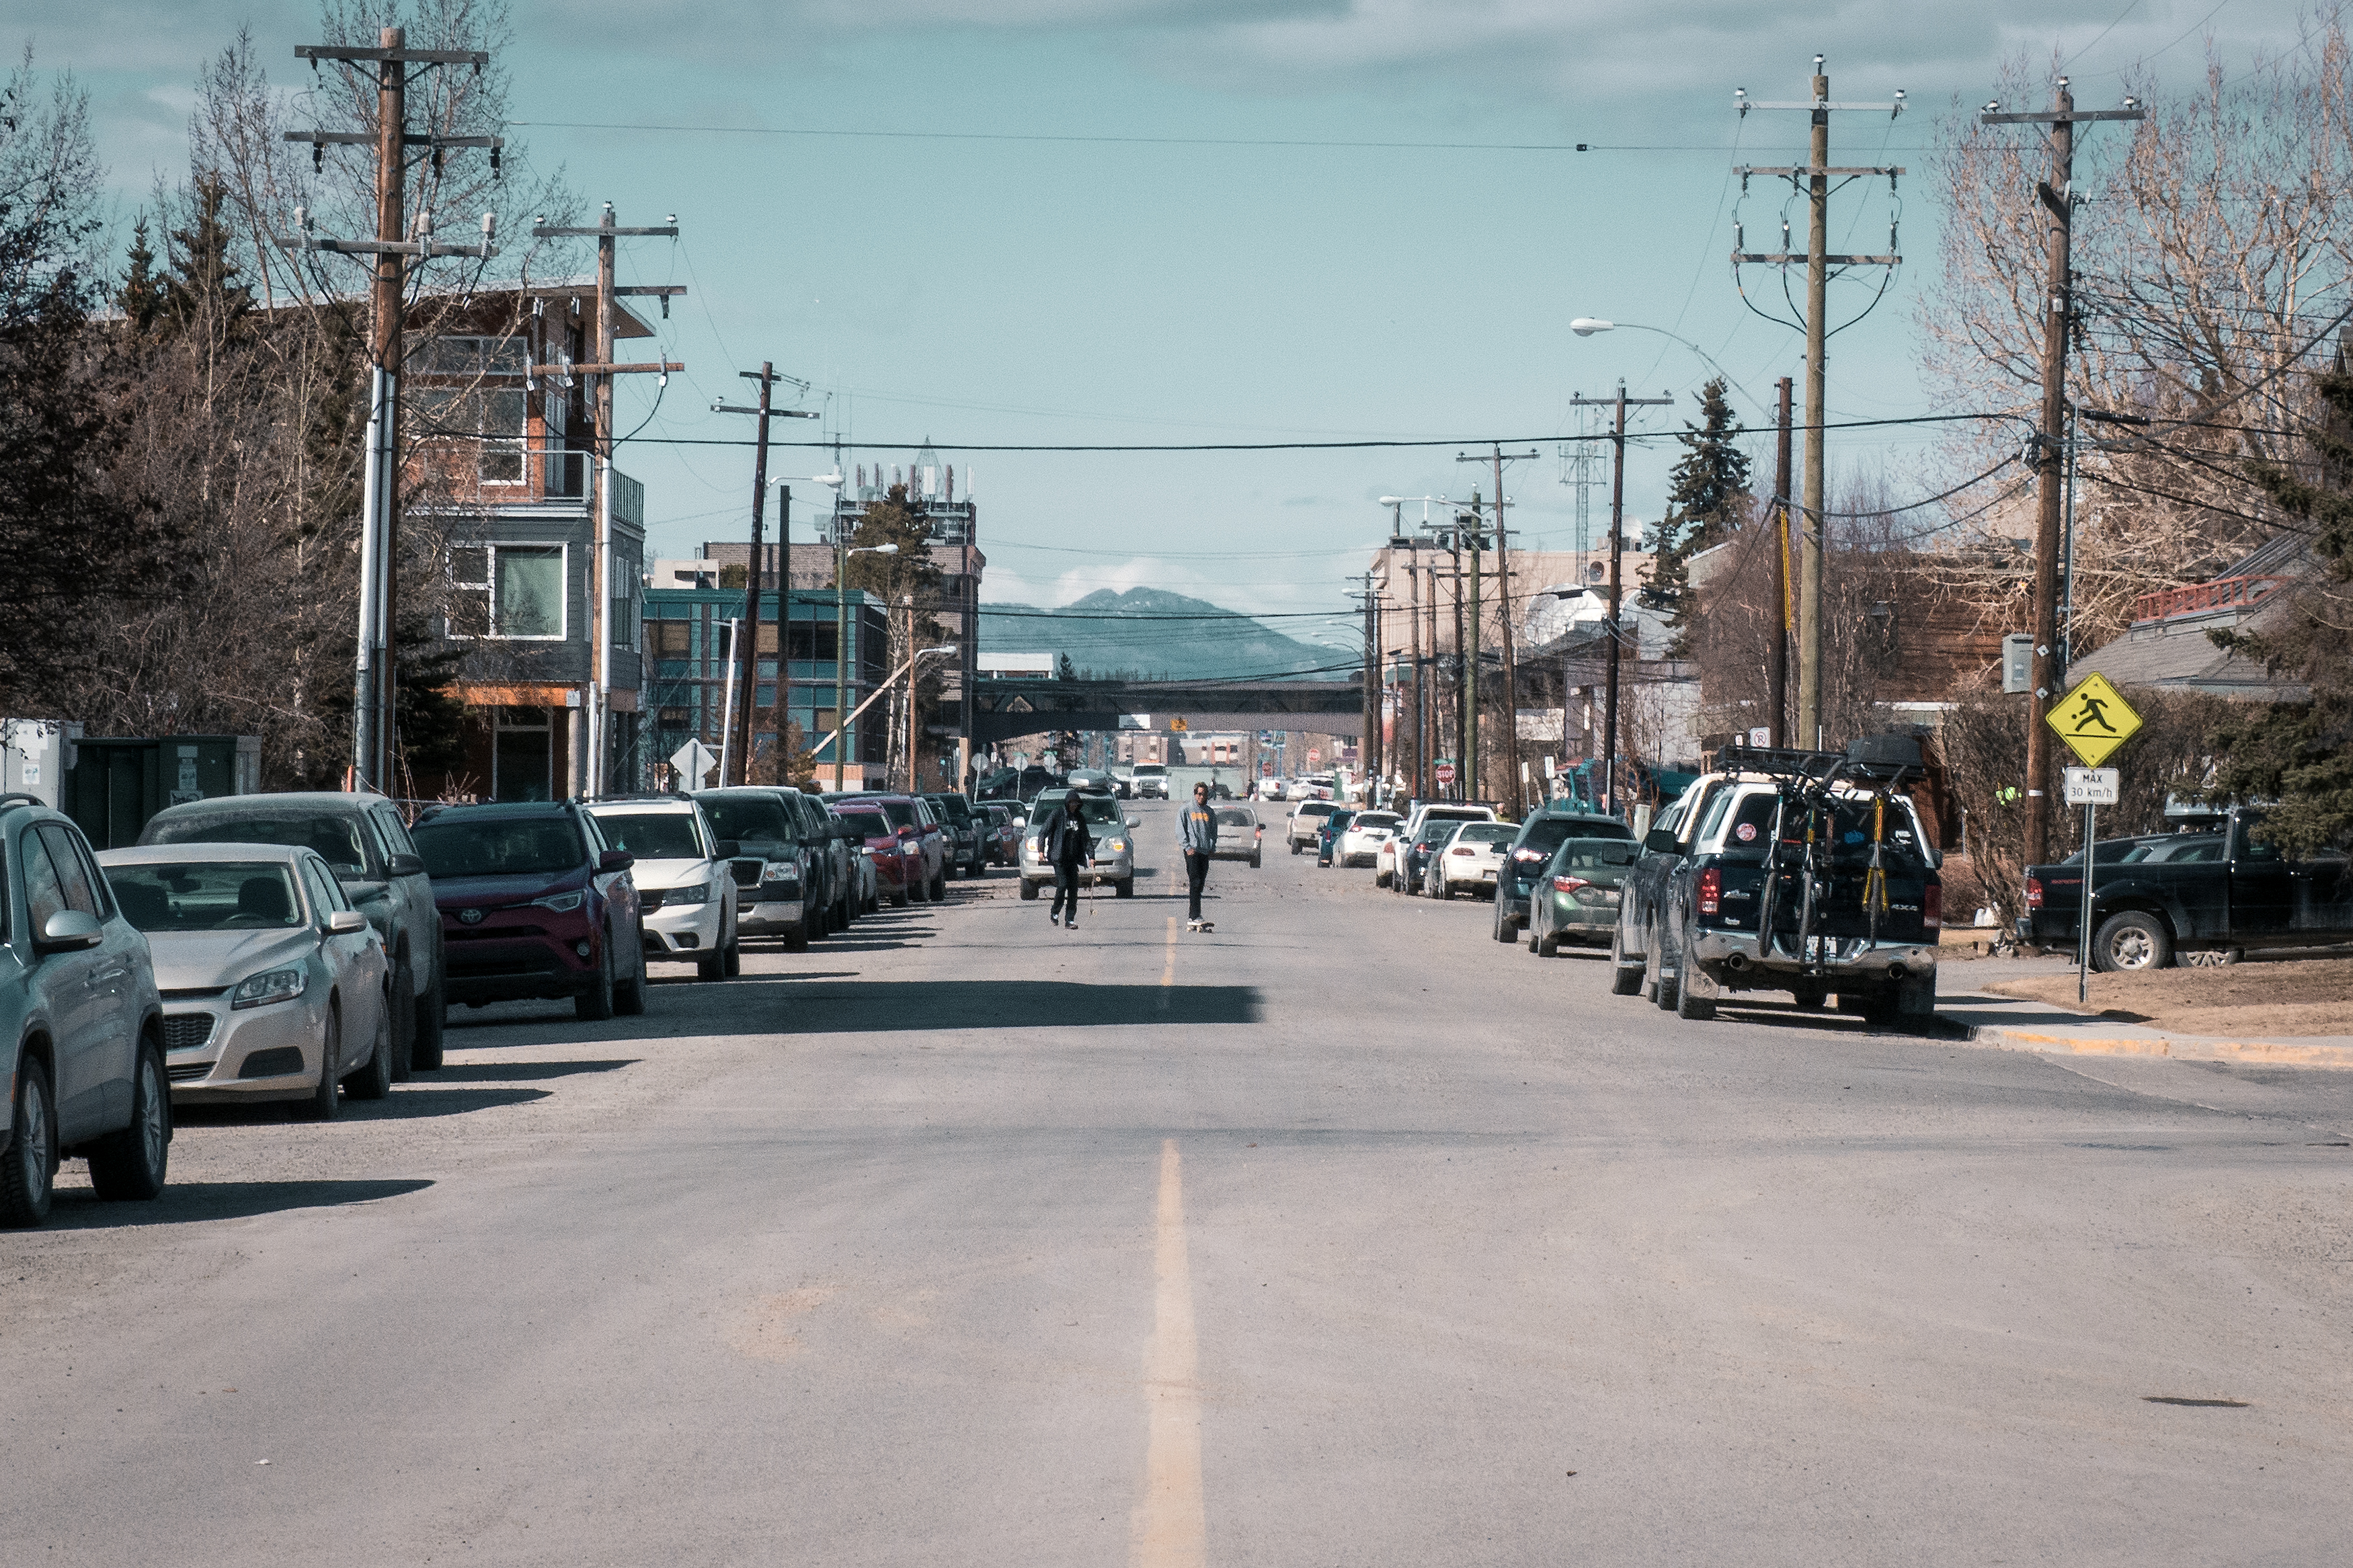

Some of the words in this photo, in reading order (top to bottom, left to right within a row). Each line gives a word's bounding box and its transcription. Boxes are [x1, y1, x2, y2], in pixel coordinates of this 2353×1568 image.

[1437, 770, 1454, 778] STOP
[2082, 774, 2103, 784] MAX
[2071, 786, 2083, 797] 30
[2087, 787, 2112, 798] km/h
